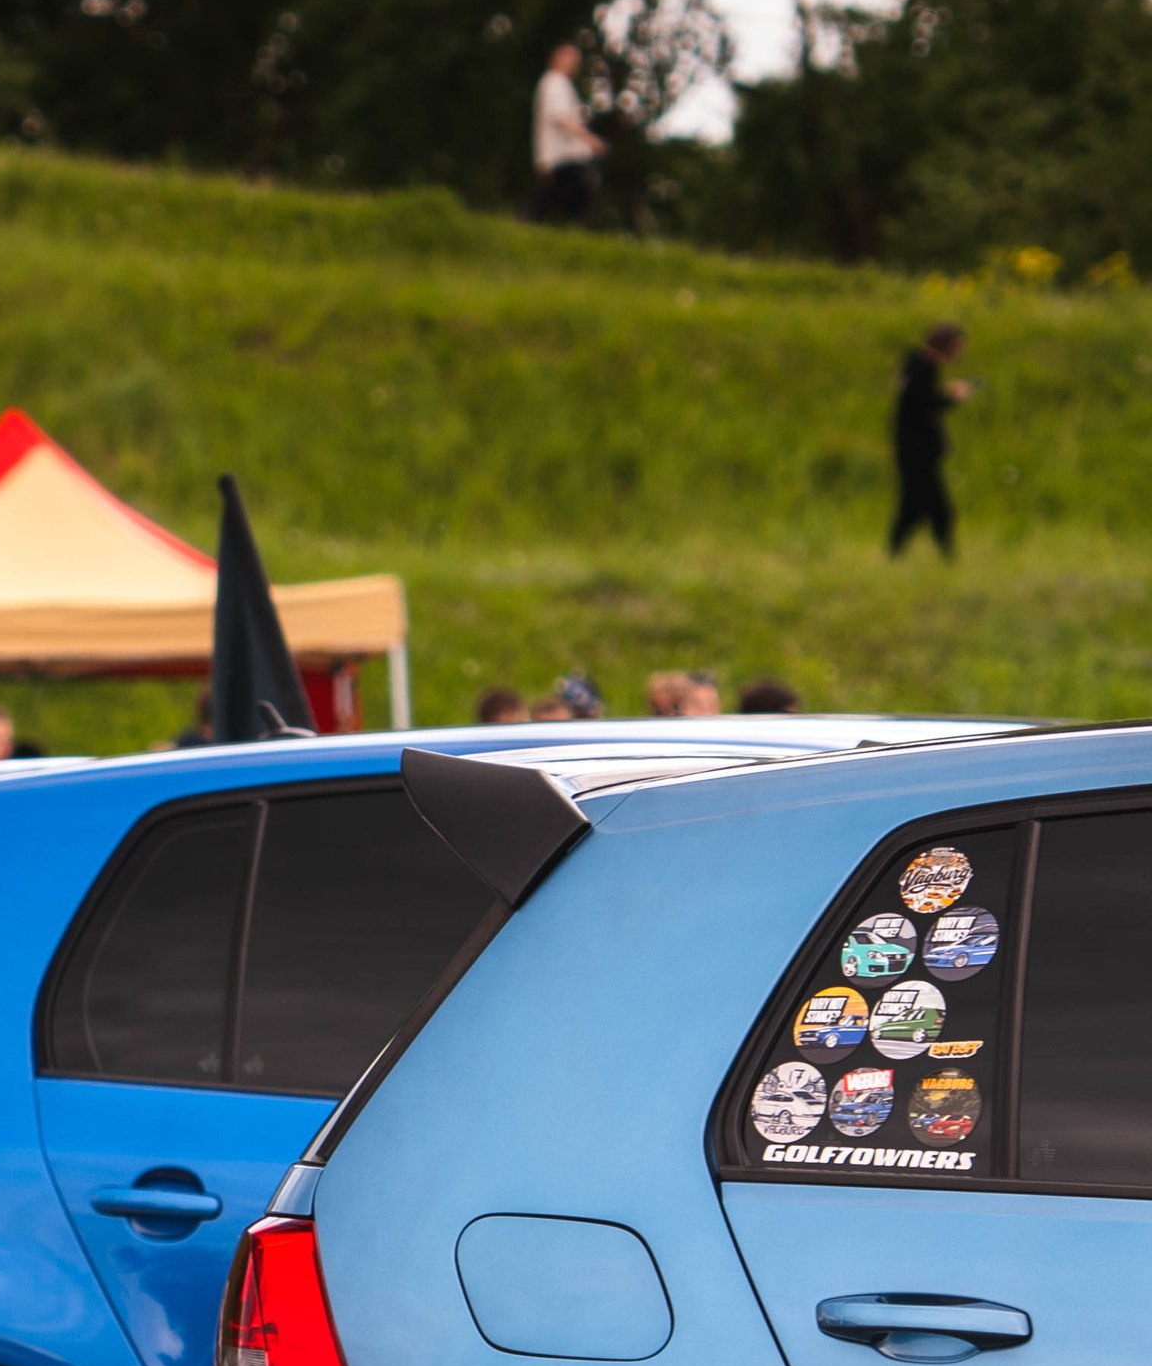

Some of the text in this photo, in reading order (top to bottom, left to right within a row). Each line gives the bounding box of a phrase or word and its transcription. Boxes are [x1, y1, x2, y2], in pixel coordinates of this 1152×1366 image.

[900, 866, 972, 894] Vagburg
[847, 1071, 891, 1091] VAGBURG
[921, 1078, 975, 1091] VAGBURG
[762, 1144, 977, 1171] GOLF7OWNERS
